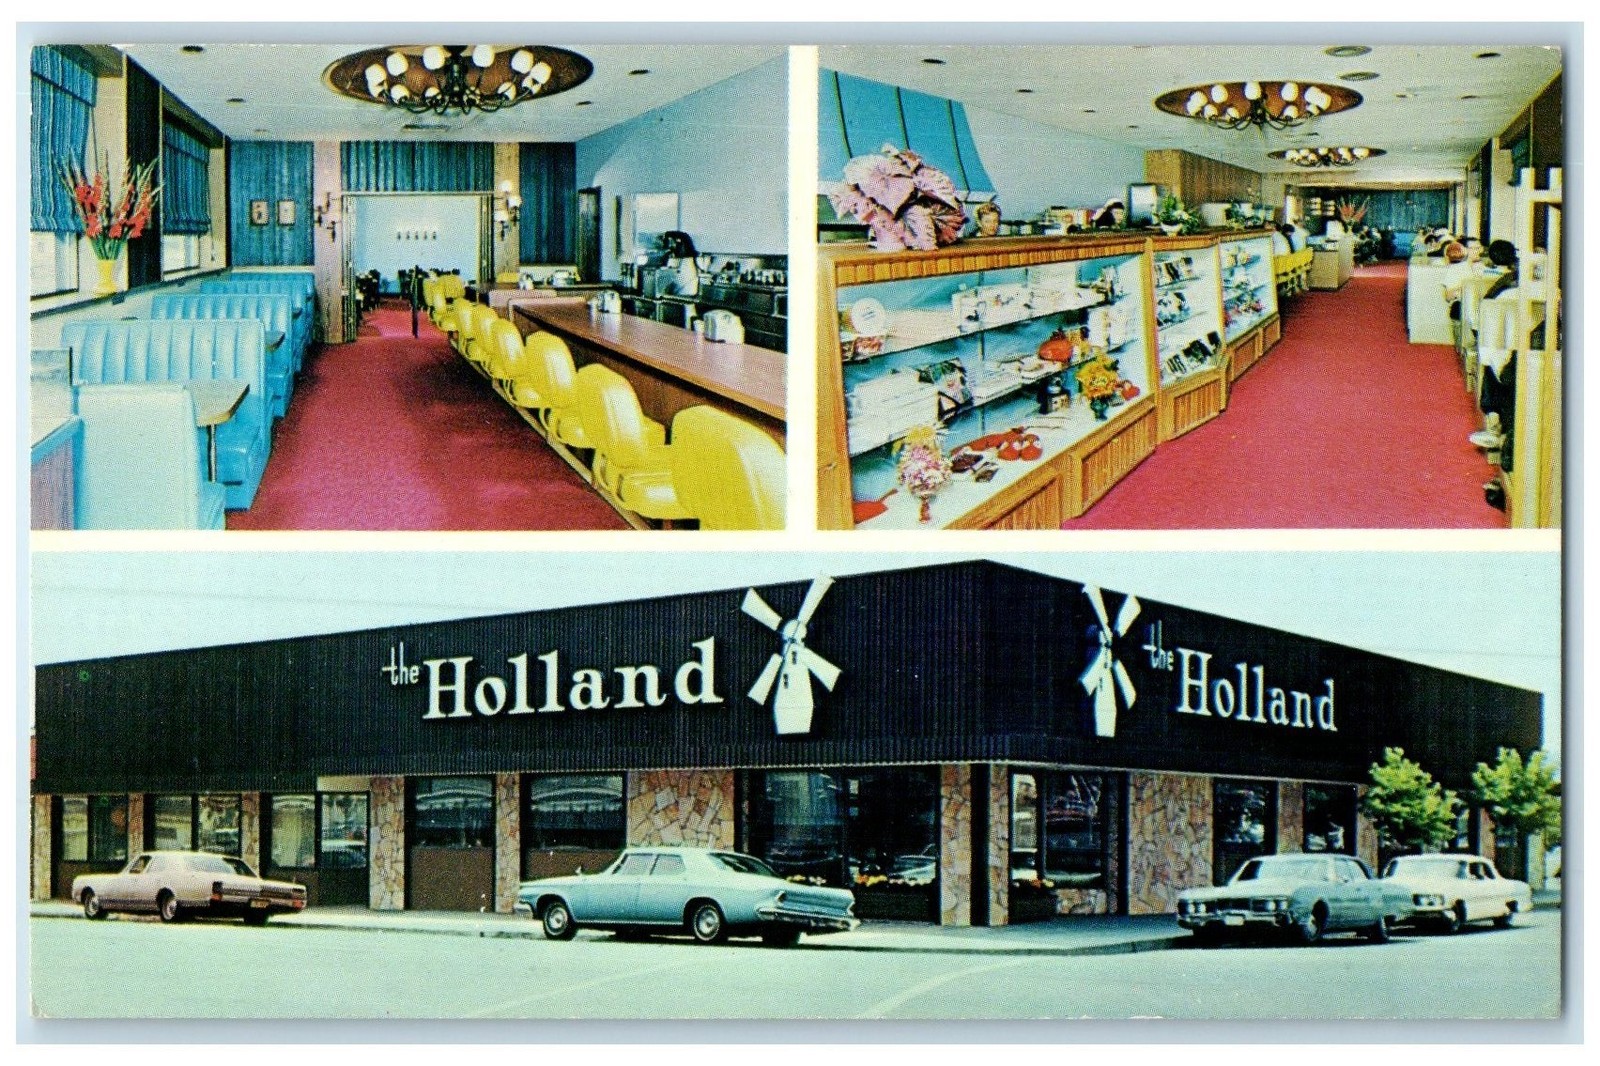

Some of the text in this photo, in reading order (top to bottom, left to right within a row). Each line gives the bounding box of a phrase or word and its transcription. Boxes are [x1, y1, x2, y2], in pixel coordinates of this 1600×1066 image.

[381, 636, 725, 719] the Holland
[1142, 619, 1338, 732] the Holland
